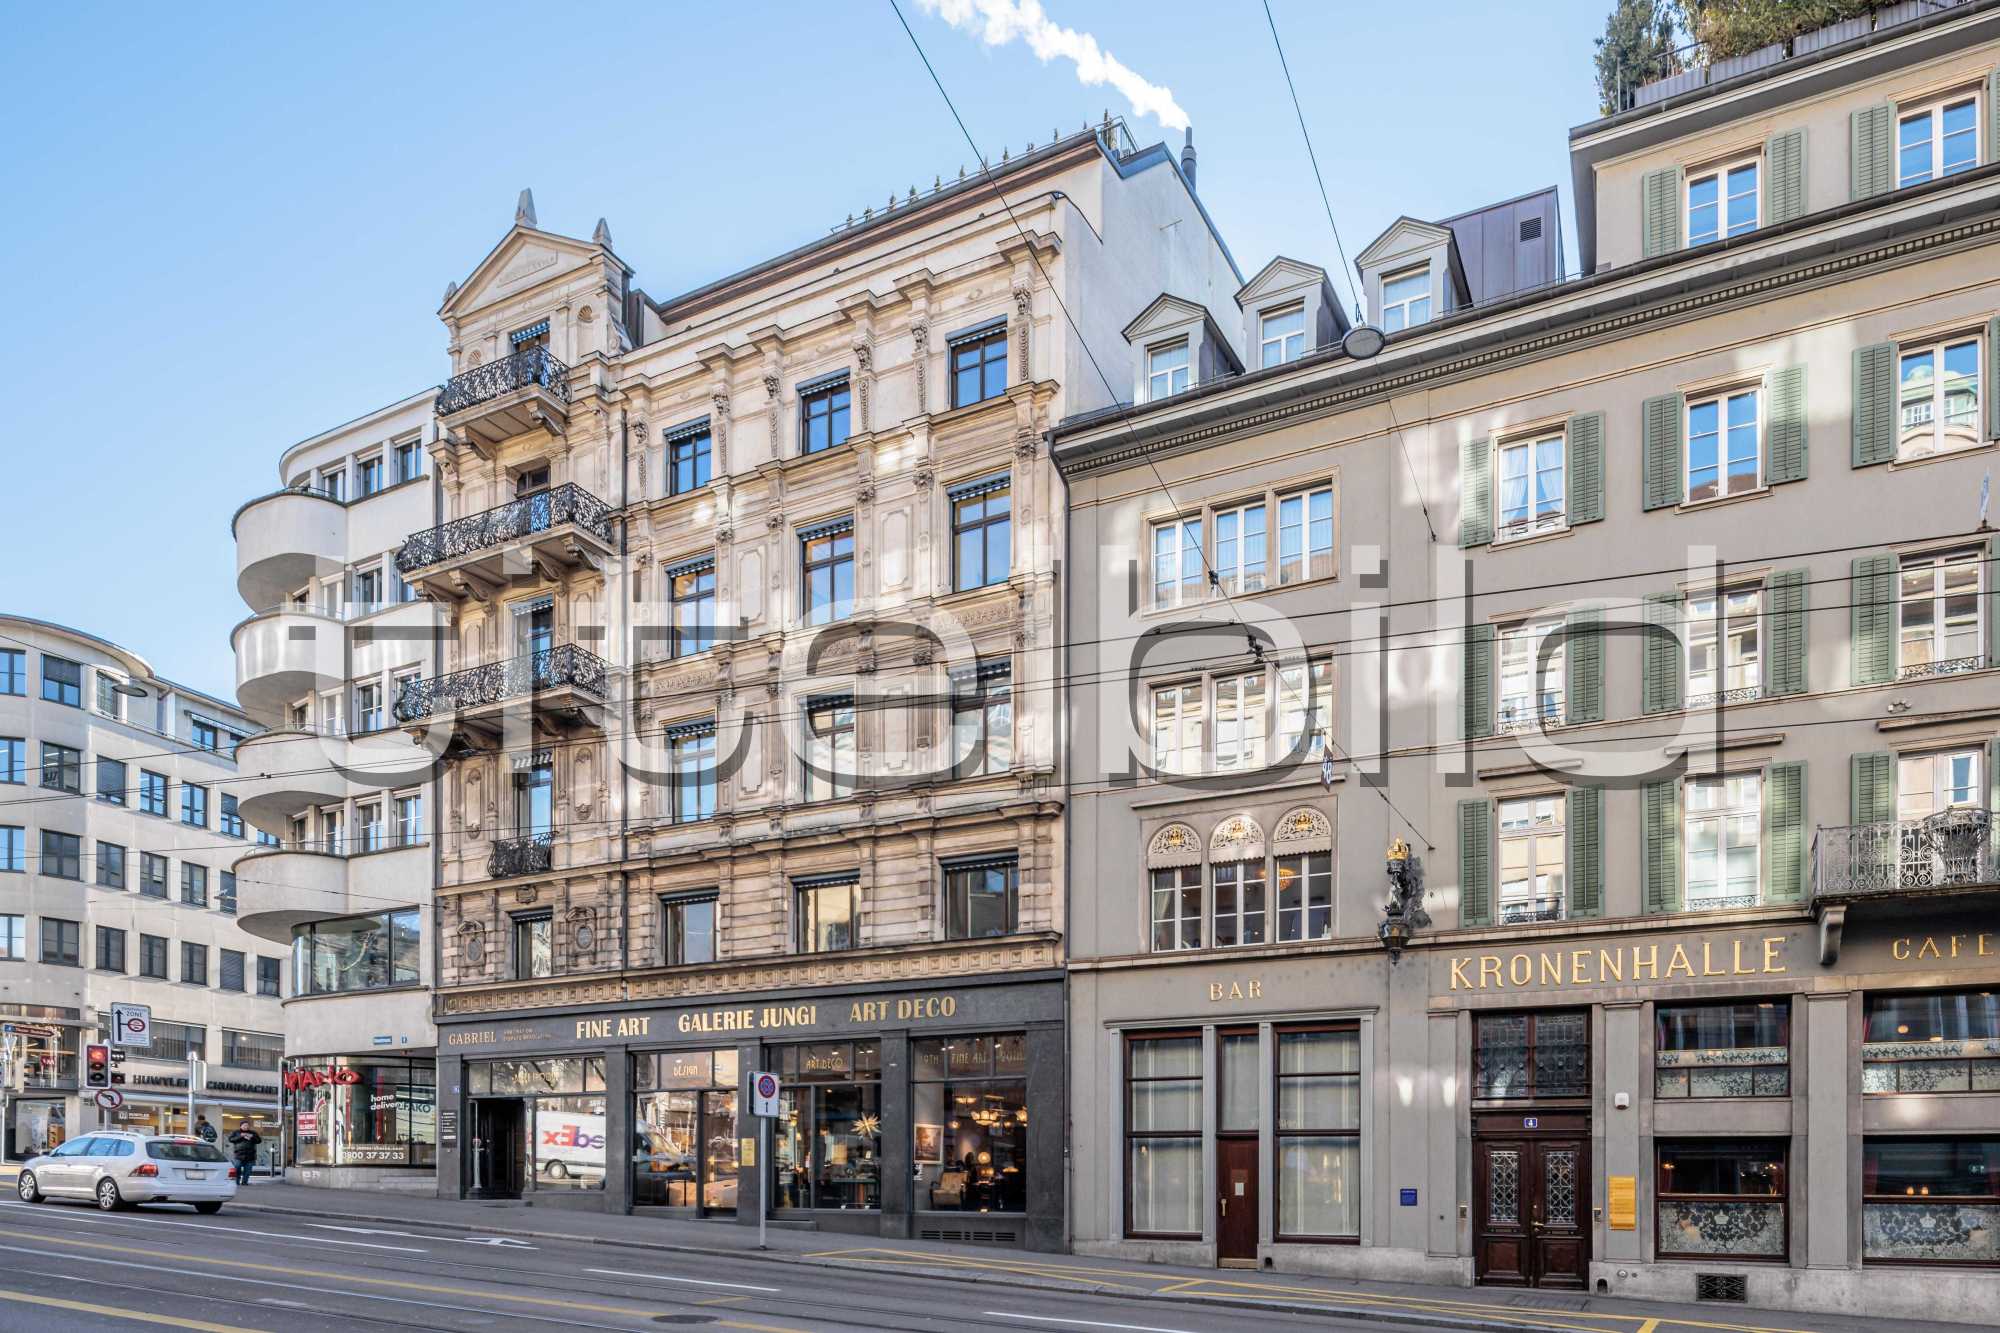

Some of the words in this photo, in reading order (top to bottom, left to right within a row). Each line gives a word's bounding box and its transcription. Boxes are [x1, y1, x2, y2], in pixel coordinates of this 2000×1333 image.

[1893, 933, 1994, 960] CAFE
[1450, 937, 1786, 990] KRONENHALLE
[1209, 980, 1262, 1001] BAR
[678, 1010, 754, 1032] GALERIE
[760, 1006, 816, 1028] JUNGI
[849, 1001, 890, 1022] ART
[897, 996, 956, 1020] DECO
[448, 1031, 497, 1046] GABRIEL
[576, 1019, 612, 1039] FINE
[617, 1017, 650, 1037] ART
[371, 1094, 394, 1102] home
